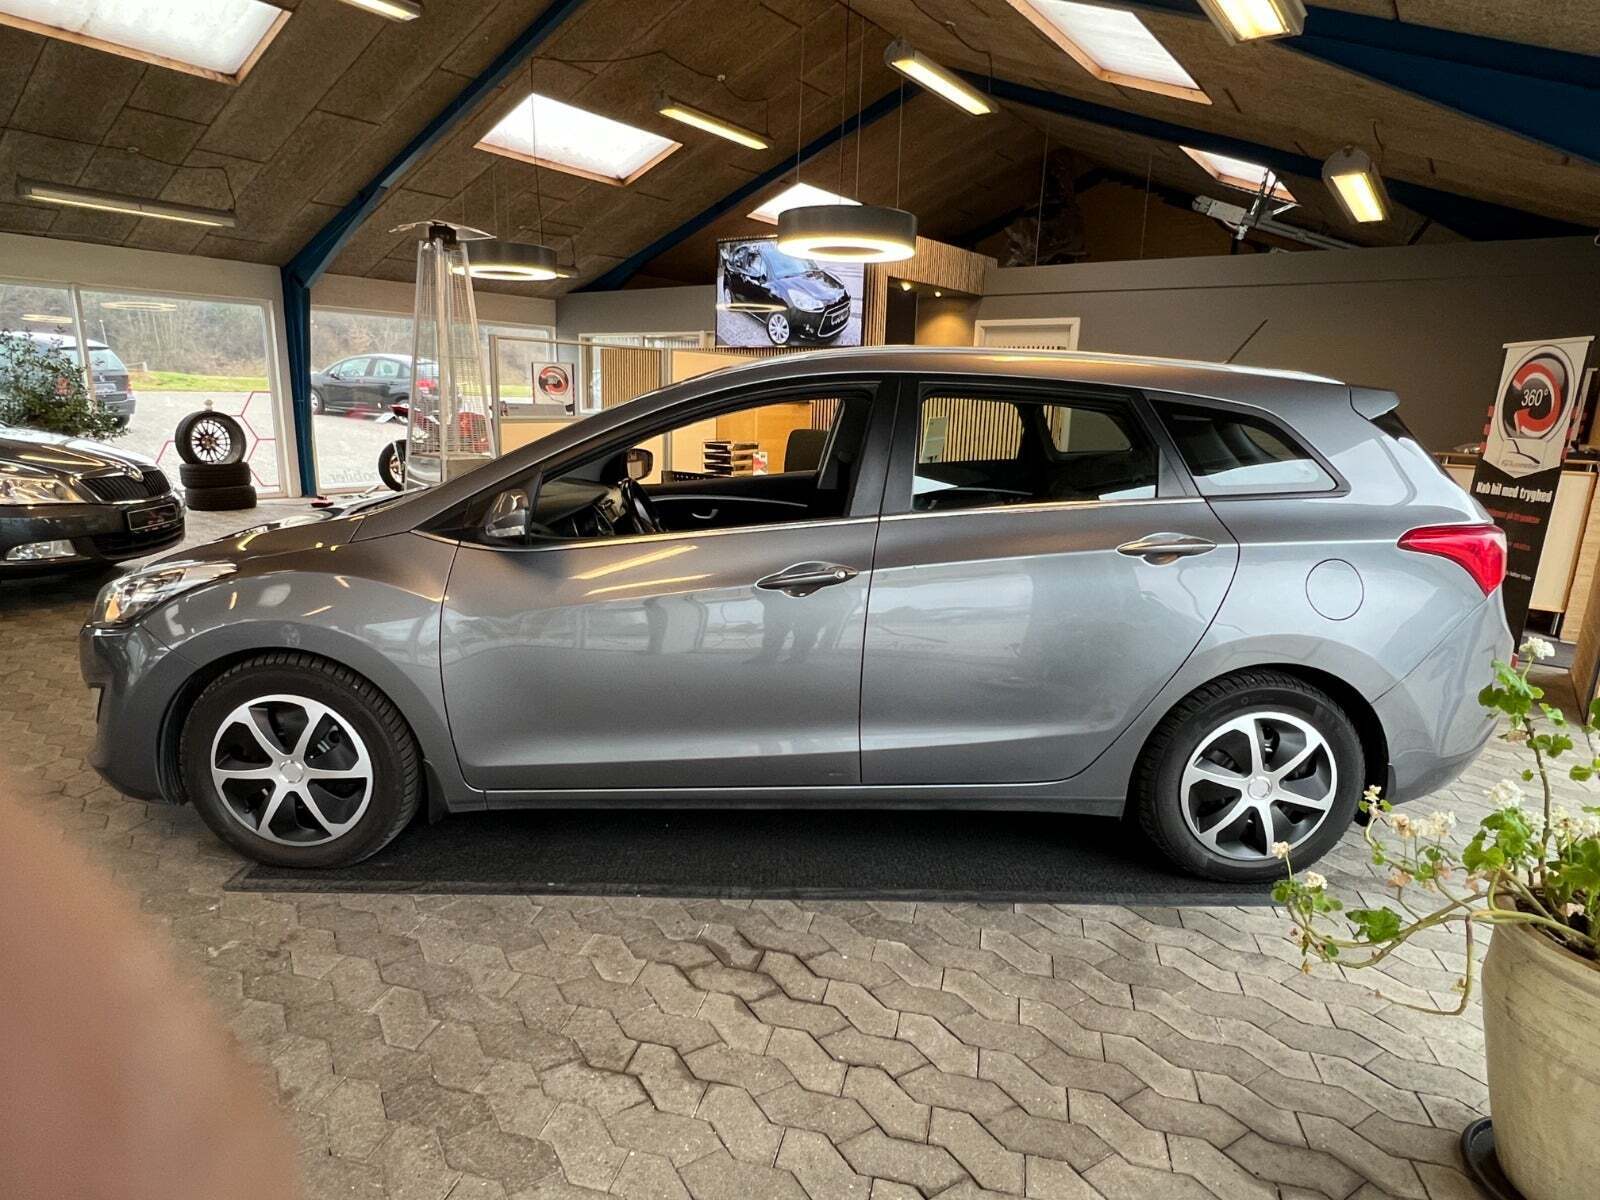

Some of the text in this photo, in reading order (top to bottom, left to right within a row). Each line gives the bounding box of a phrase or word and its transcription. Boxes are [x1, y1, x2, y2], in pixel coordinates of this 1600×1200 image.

[1521, 388, 1549, 407] 360°
[1490, 482, 1502, 496] bil
[1501, 485, 1519, 498] med
[1519, 487, 1553, 503] tryghed
